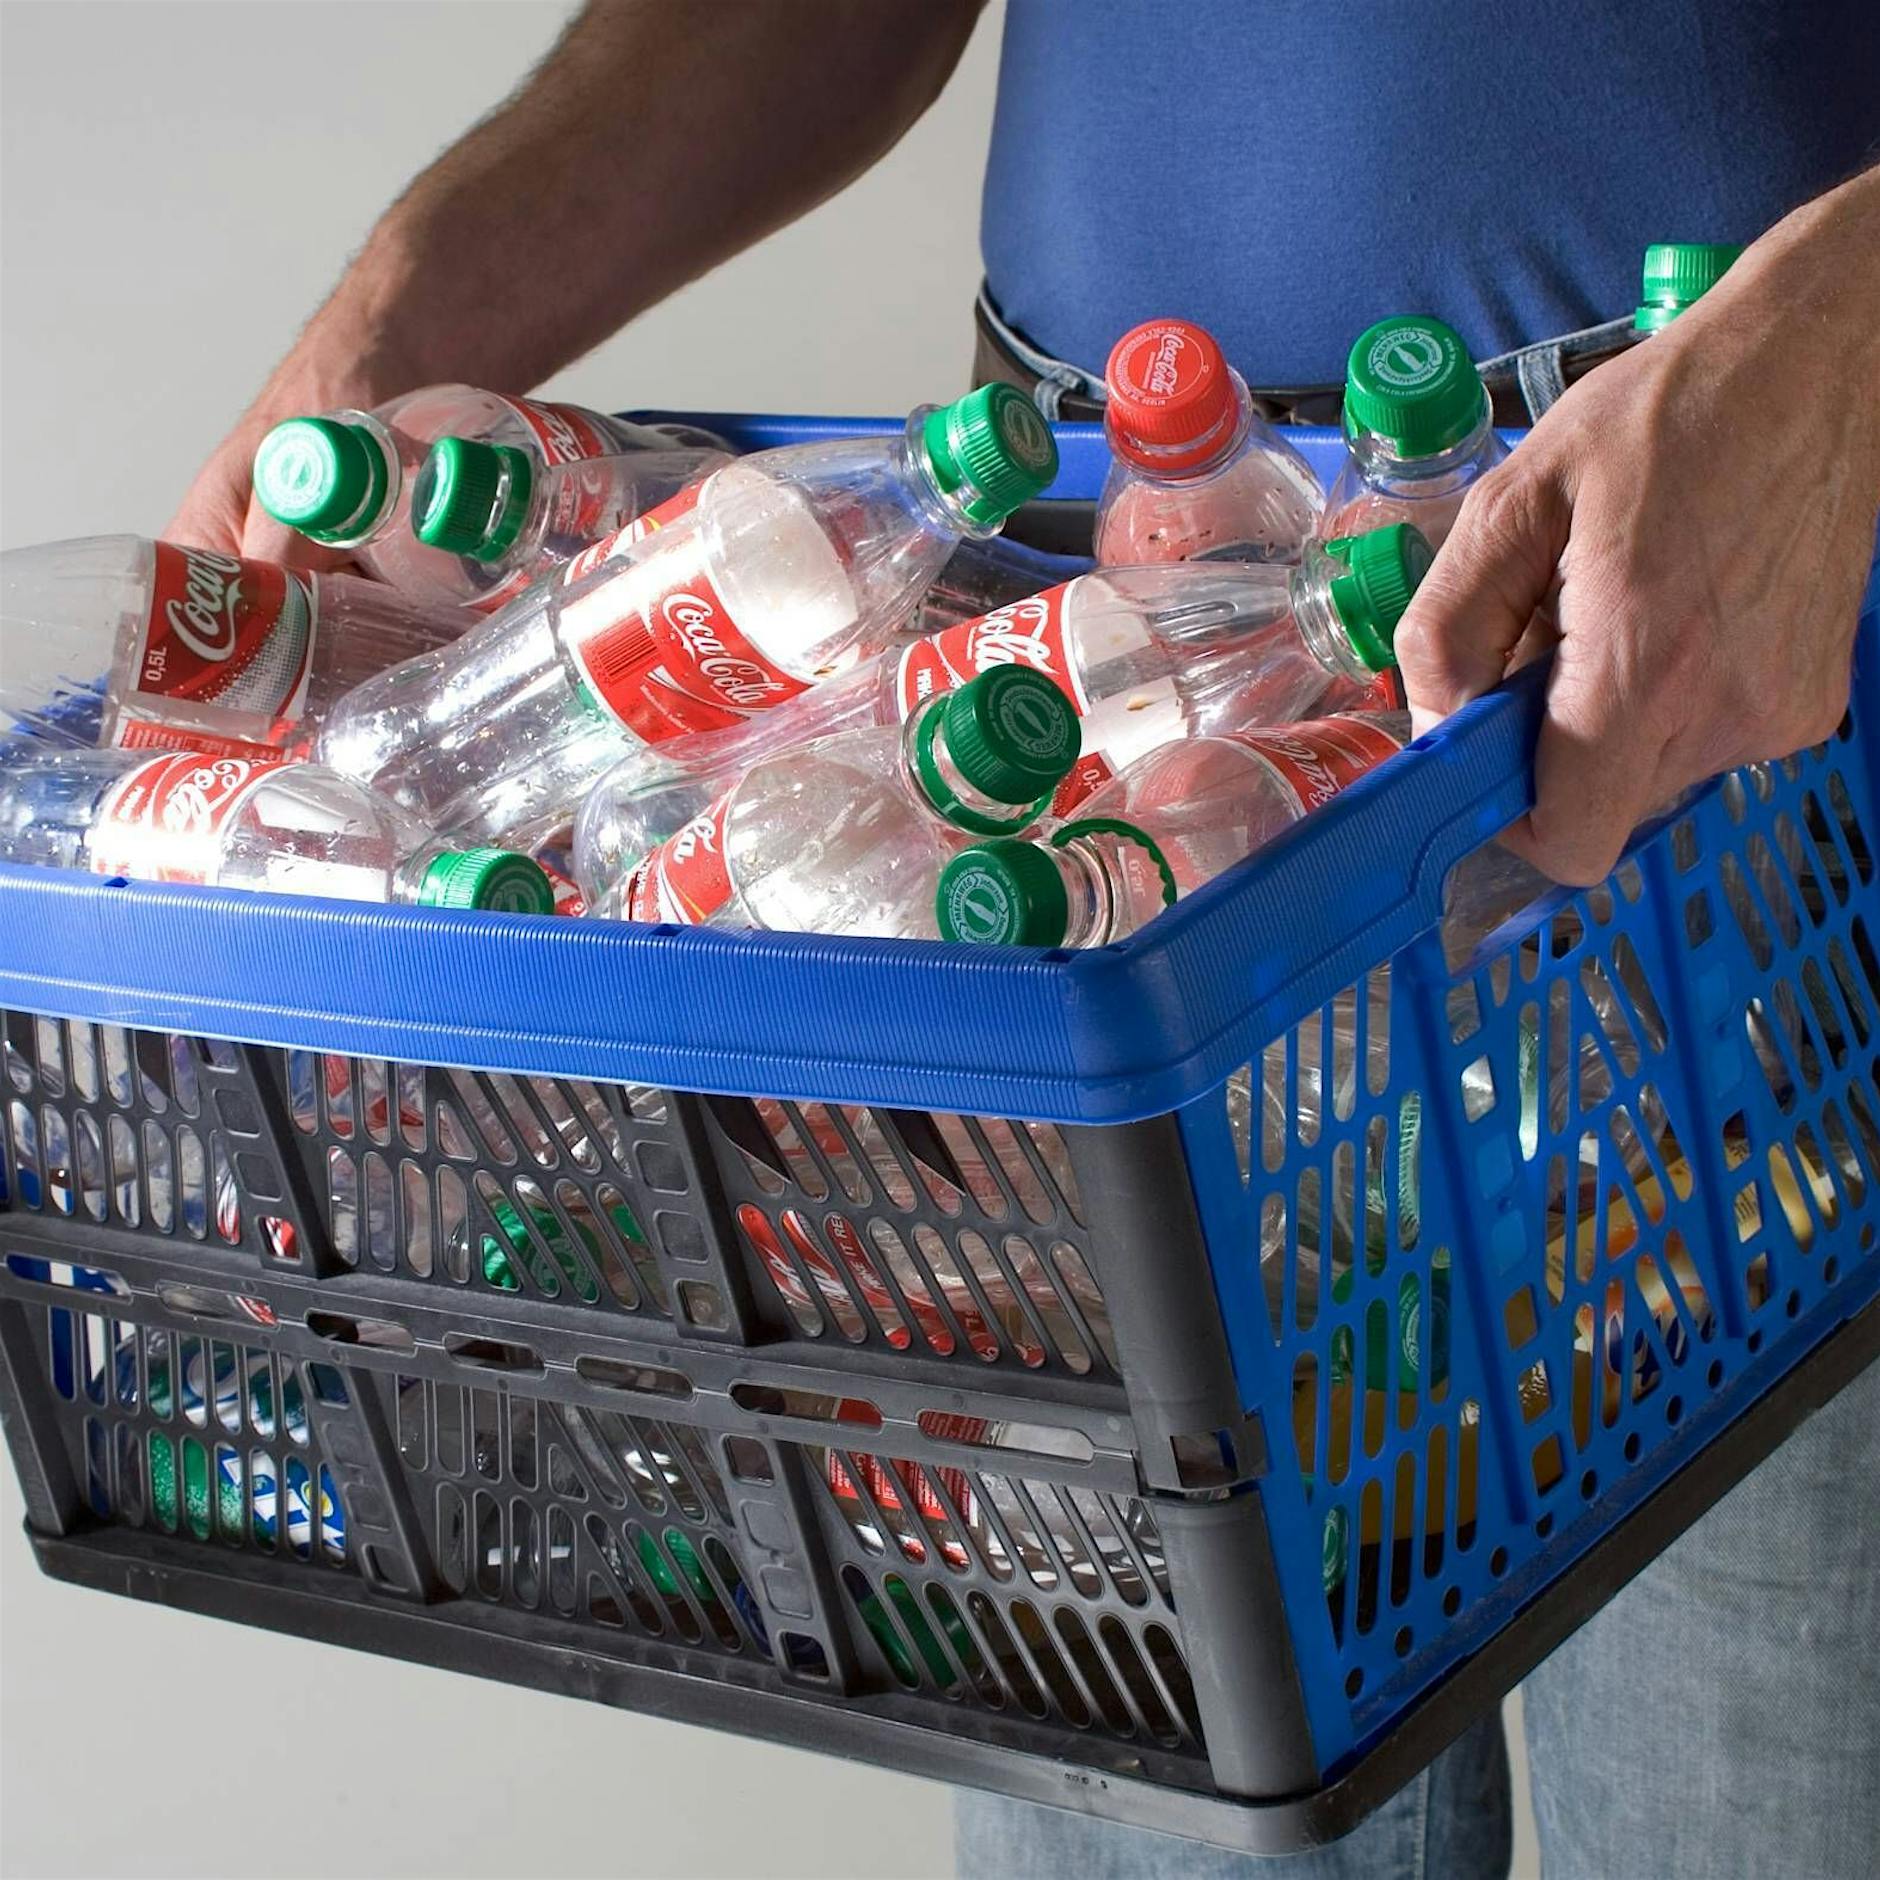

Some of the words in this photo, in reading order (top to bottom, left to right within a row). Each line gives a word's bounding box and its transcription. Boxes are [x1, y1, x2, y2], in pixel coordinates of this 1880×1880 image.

[1150, 333, 1185, 397] Coca-Cola
[144, 646, 168, 682] 0,5L
[661, 592, 791, 705] Coca-Cola
[839, 1241, 858, 1258] IT
